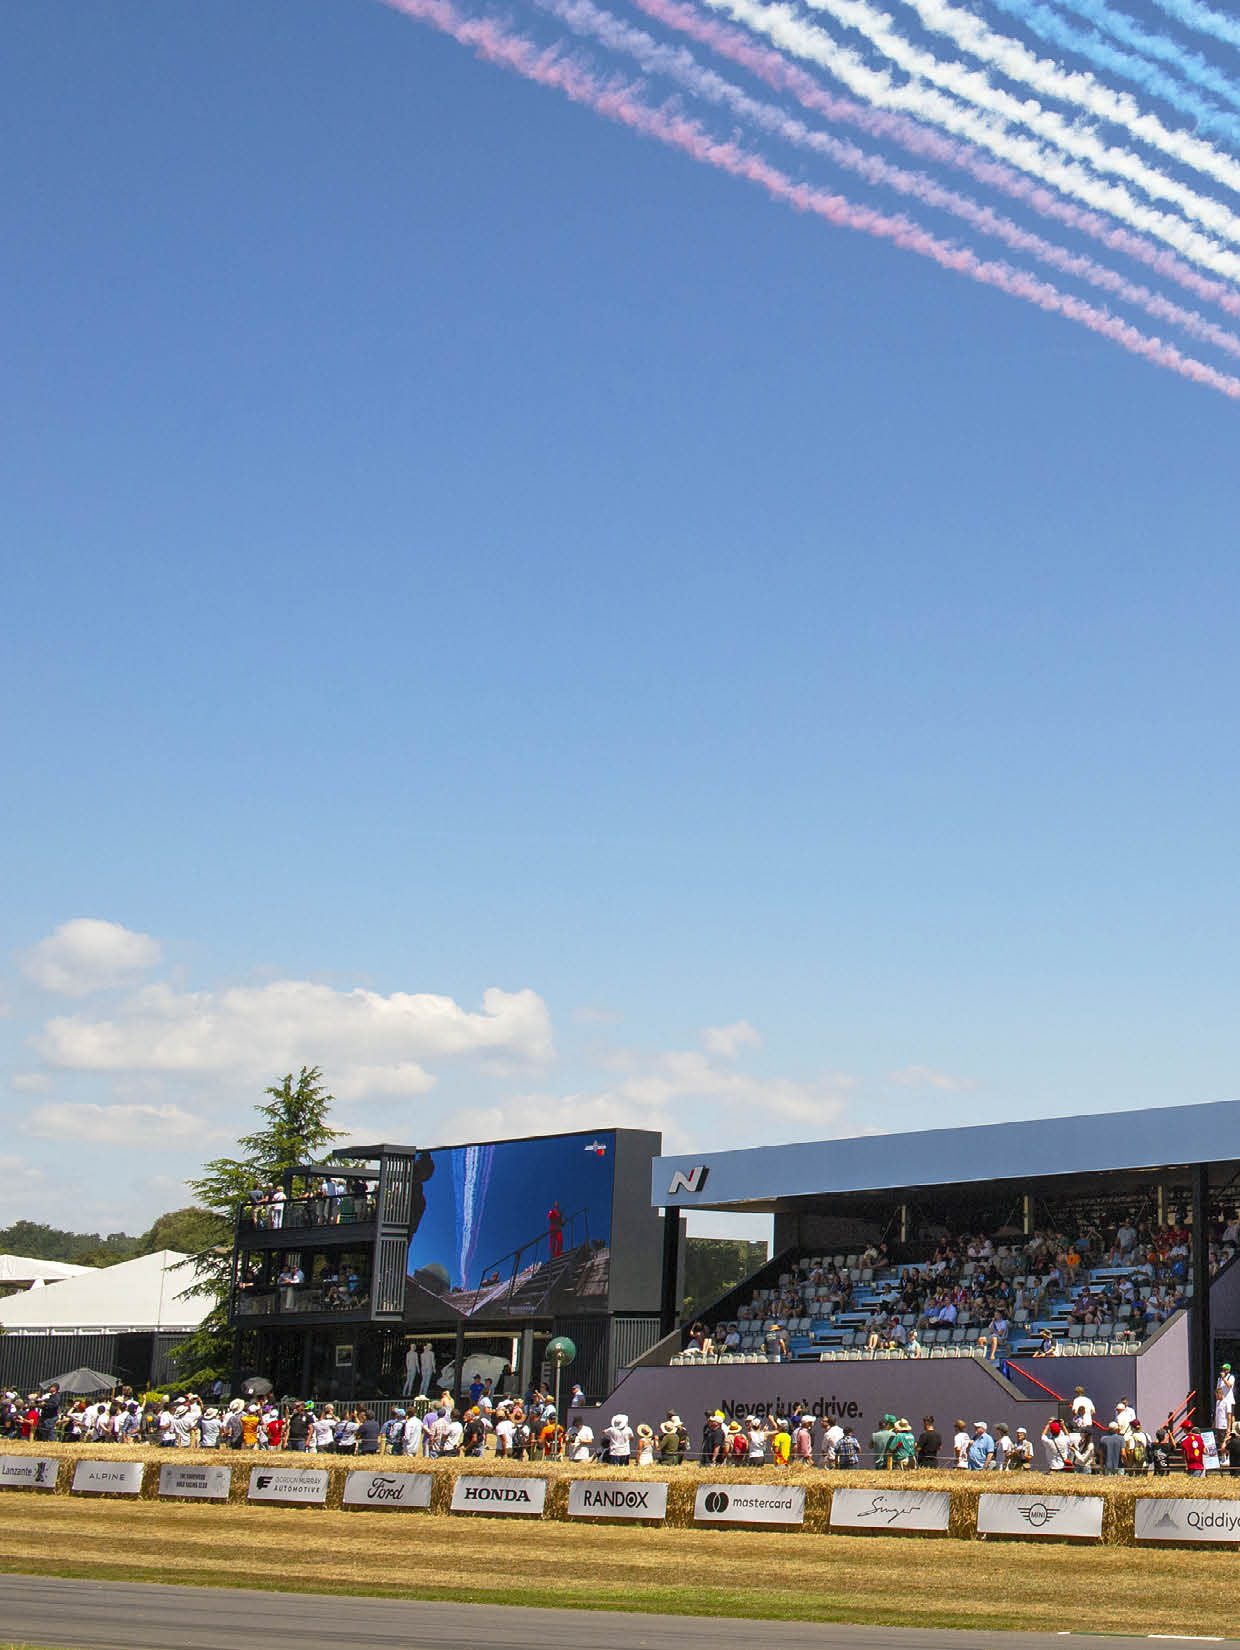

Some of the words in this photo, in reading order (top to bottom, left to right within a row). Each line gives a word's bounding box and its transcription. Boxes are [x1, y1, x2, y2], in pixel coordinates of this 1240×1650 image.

[721, 1399, 773, 1420] Never
[812, 1395, 864, 1419] drive.
[2, 1463, 33, 1477] Lanzante
[88, 1472, 126, 1481] ALPINE
[273, 1485, 321, 1493] AUTOMOTIVE
[367, 1477, 405, 1500] Ford
[464, 1487, 531, 1502] HONDA
[583, 1489, 649, 1509] RANDOX
[732, 1497, 792, 1510] mastercard
[1031, 1510, 1046, 1520] MINI
